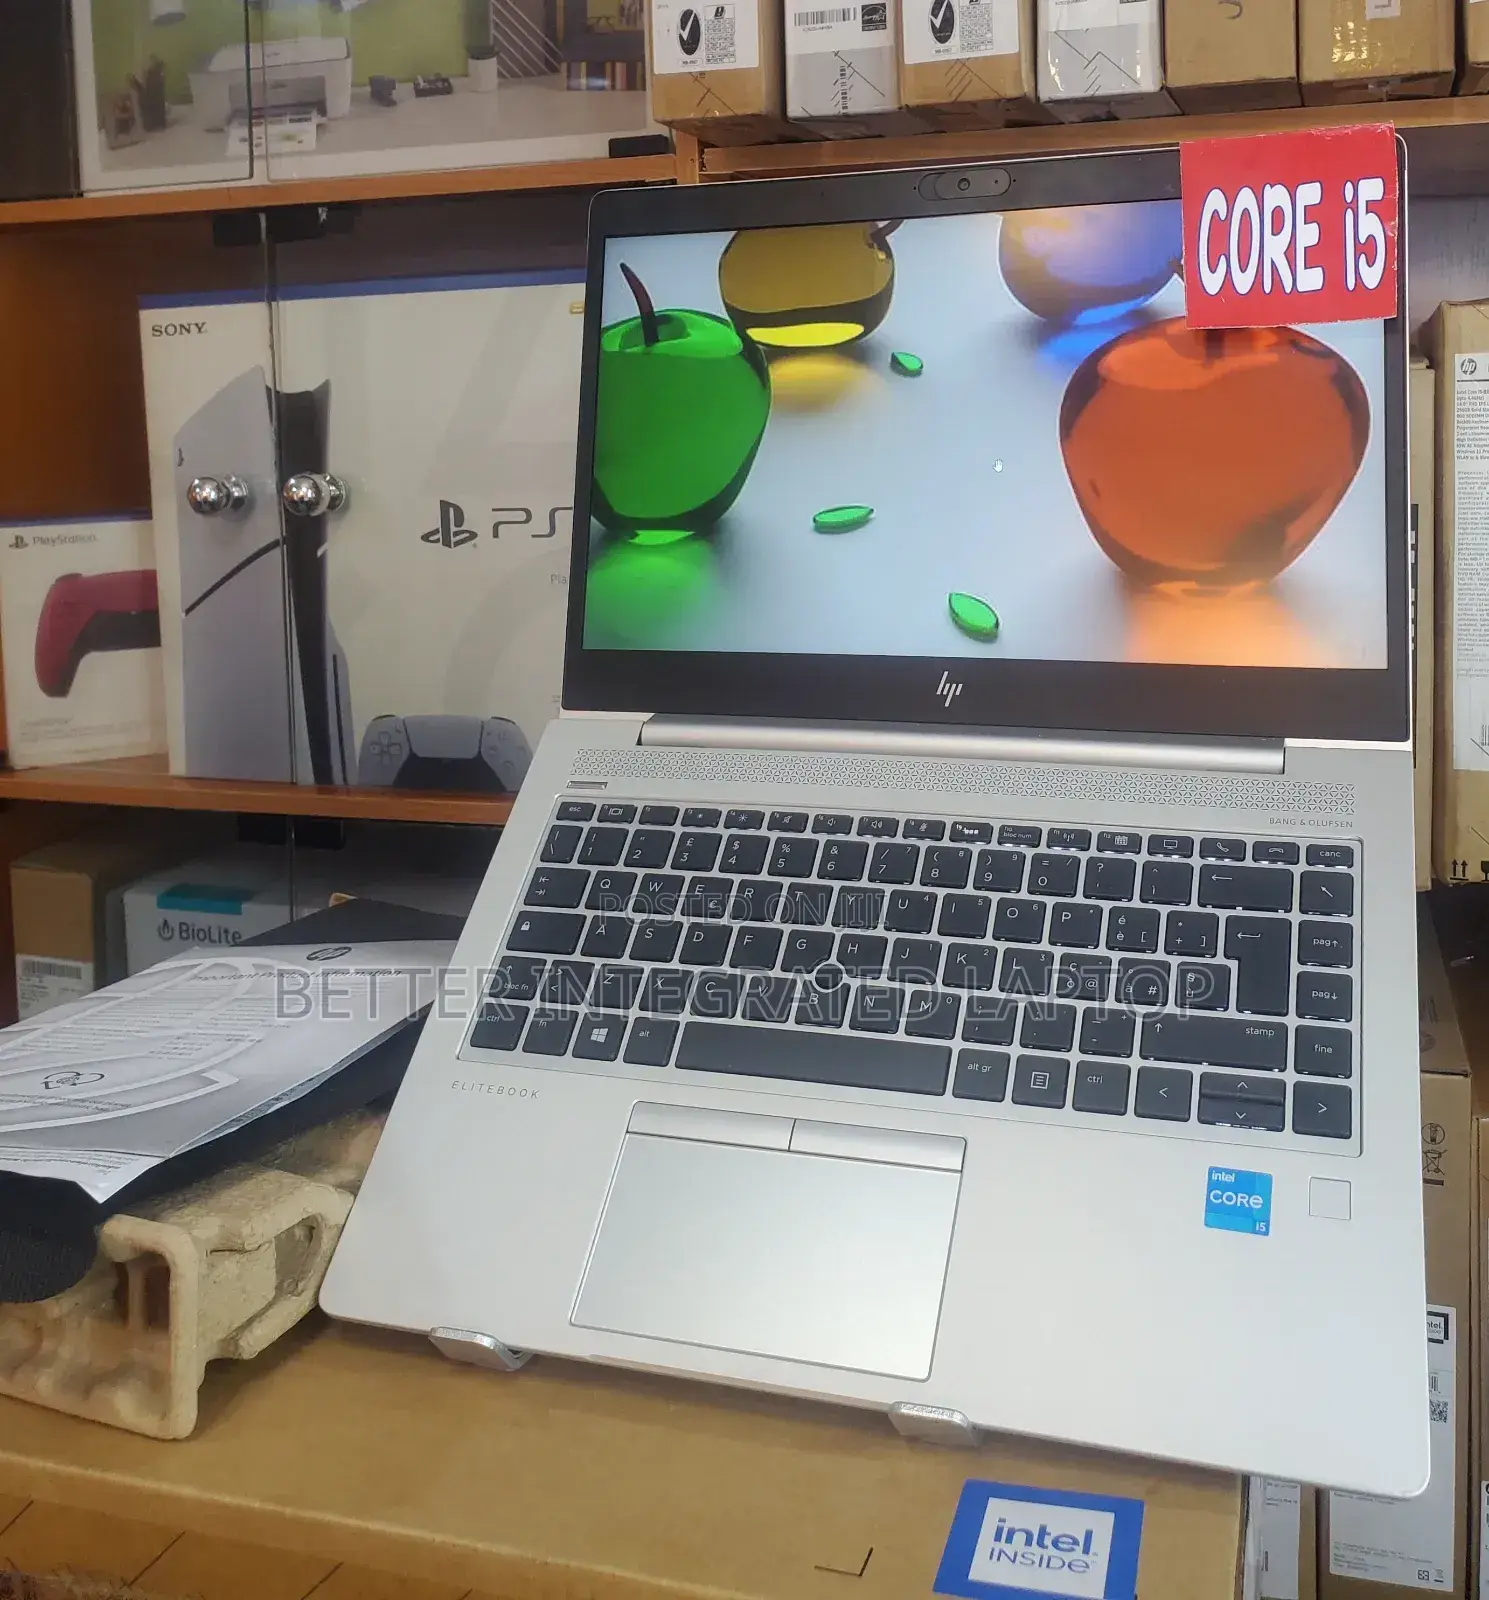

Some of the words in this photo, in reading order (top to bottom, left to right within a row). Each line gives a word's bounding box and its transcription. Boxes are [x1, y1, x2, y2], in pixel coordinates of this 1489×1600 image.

[1198, 181, 1325, 296] CORE
[1344, 177, 1387, 291] i5
[151, 322, 207, 337] SONY
[1460, 358, 1476, 375] hp
[936, 671, 963, 707] hp
[1269, 817, 1296, 827] BANG
[1297, 819, 1305, 827] &
[1309, 818, 1353, 828] OLUFSEN
[588, 847, 592, 855] 1
[633, 850, 641, 858] 2
[680, 853, 689, 861] 3
[729, 855, 736, 864] 4
[777, 859, 785, 867] 5
[827, 861, 835, 870] 6
[879, 865, 886, 873] 7
[931, 869, 939, 877] 8
[984, 872, 992, 881] 9
[600, 879, 610, 888] Q
[649, 882, 663, 892] W
[695, 885, 704, 895] E
[744, 888, 754, 899] R
[794, 891, 803, 902] T
[847, 895, 856, 905] Y
[899, 899, 908, 909] U
[1062, 912, 1071, 922] P
[1119, 915, 1125, 924] é
[178, 921, 242, 943] BioLite
[596, 924, 606, 936] A
[645, 928, 653, 938] S
[693, 932, 703, 941] D
[744, 935, 753, 945] F
[1117, 931, 1124, 940] è
[797, 939, 806, 949] G
[848, 943, 858, 953] H
[901, 948, 909, 958] J
[957, 953, 967, 964] K
[1013, 958, 1022, 970] L
[603, 973, 614, 985] Z
[654, 977, 664, 989] X
[503, 981, 519, 990] bloc
[705, 982, 716, 993] C
[759, 986, 769, 997] V
[1312, 990, 1329, 1000] pag
[808, 993, 819, 1005] B
[864, 996, 875, 1009] N
[920, 1000, 932, 1012] M
[485, 1013, 501, 1022] ctrl
[539, 1019, 547, 1028] fn
[1246, 1027, 1274, 1037] stamp
[1315, 1044, 1332, 1053] fine
[451, 1080, 541, 1100] ELITEBOOK
[1211, 1169, 1236, 1183] intel
[1256, 1221, 1267, 1232] i5
[993, 1516, 1095, 1556] intel
